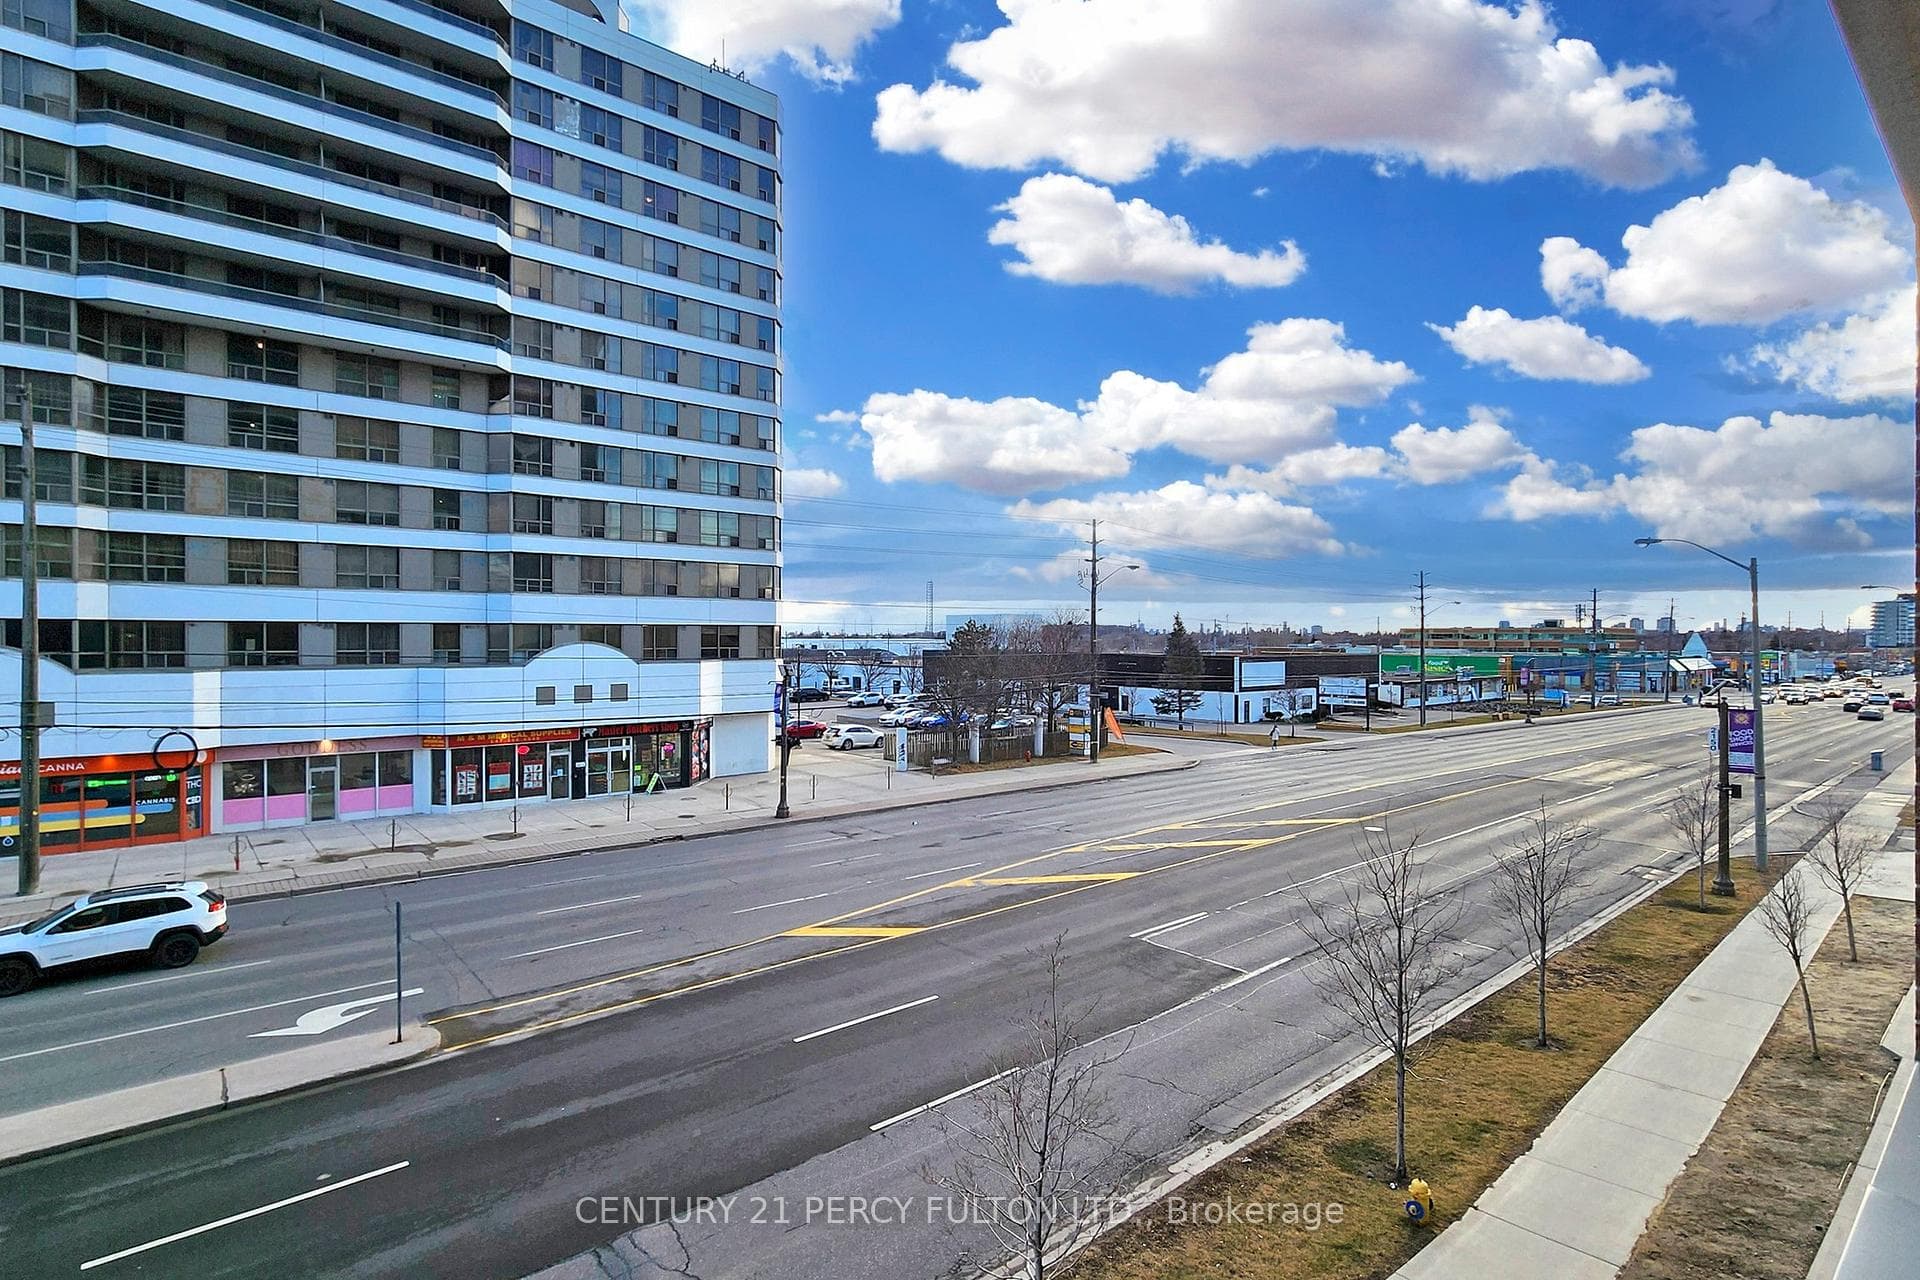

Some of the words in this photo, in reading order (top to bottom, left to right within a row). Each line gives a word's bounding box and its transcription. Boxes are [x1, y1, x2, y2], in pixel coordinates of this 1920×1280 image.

[488, 731, 528, 740] MEDICAL
[530, 728, 571, 737] SUPPLIES
[39, 763, 85, 773] CANNA
[136, 797, 176, 806] CANNABIS
